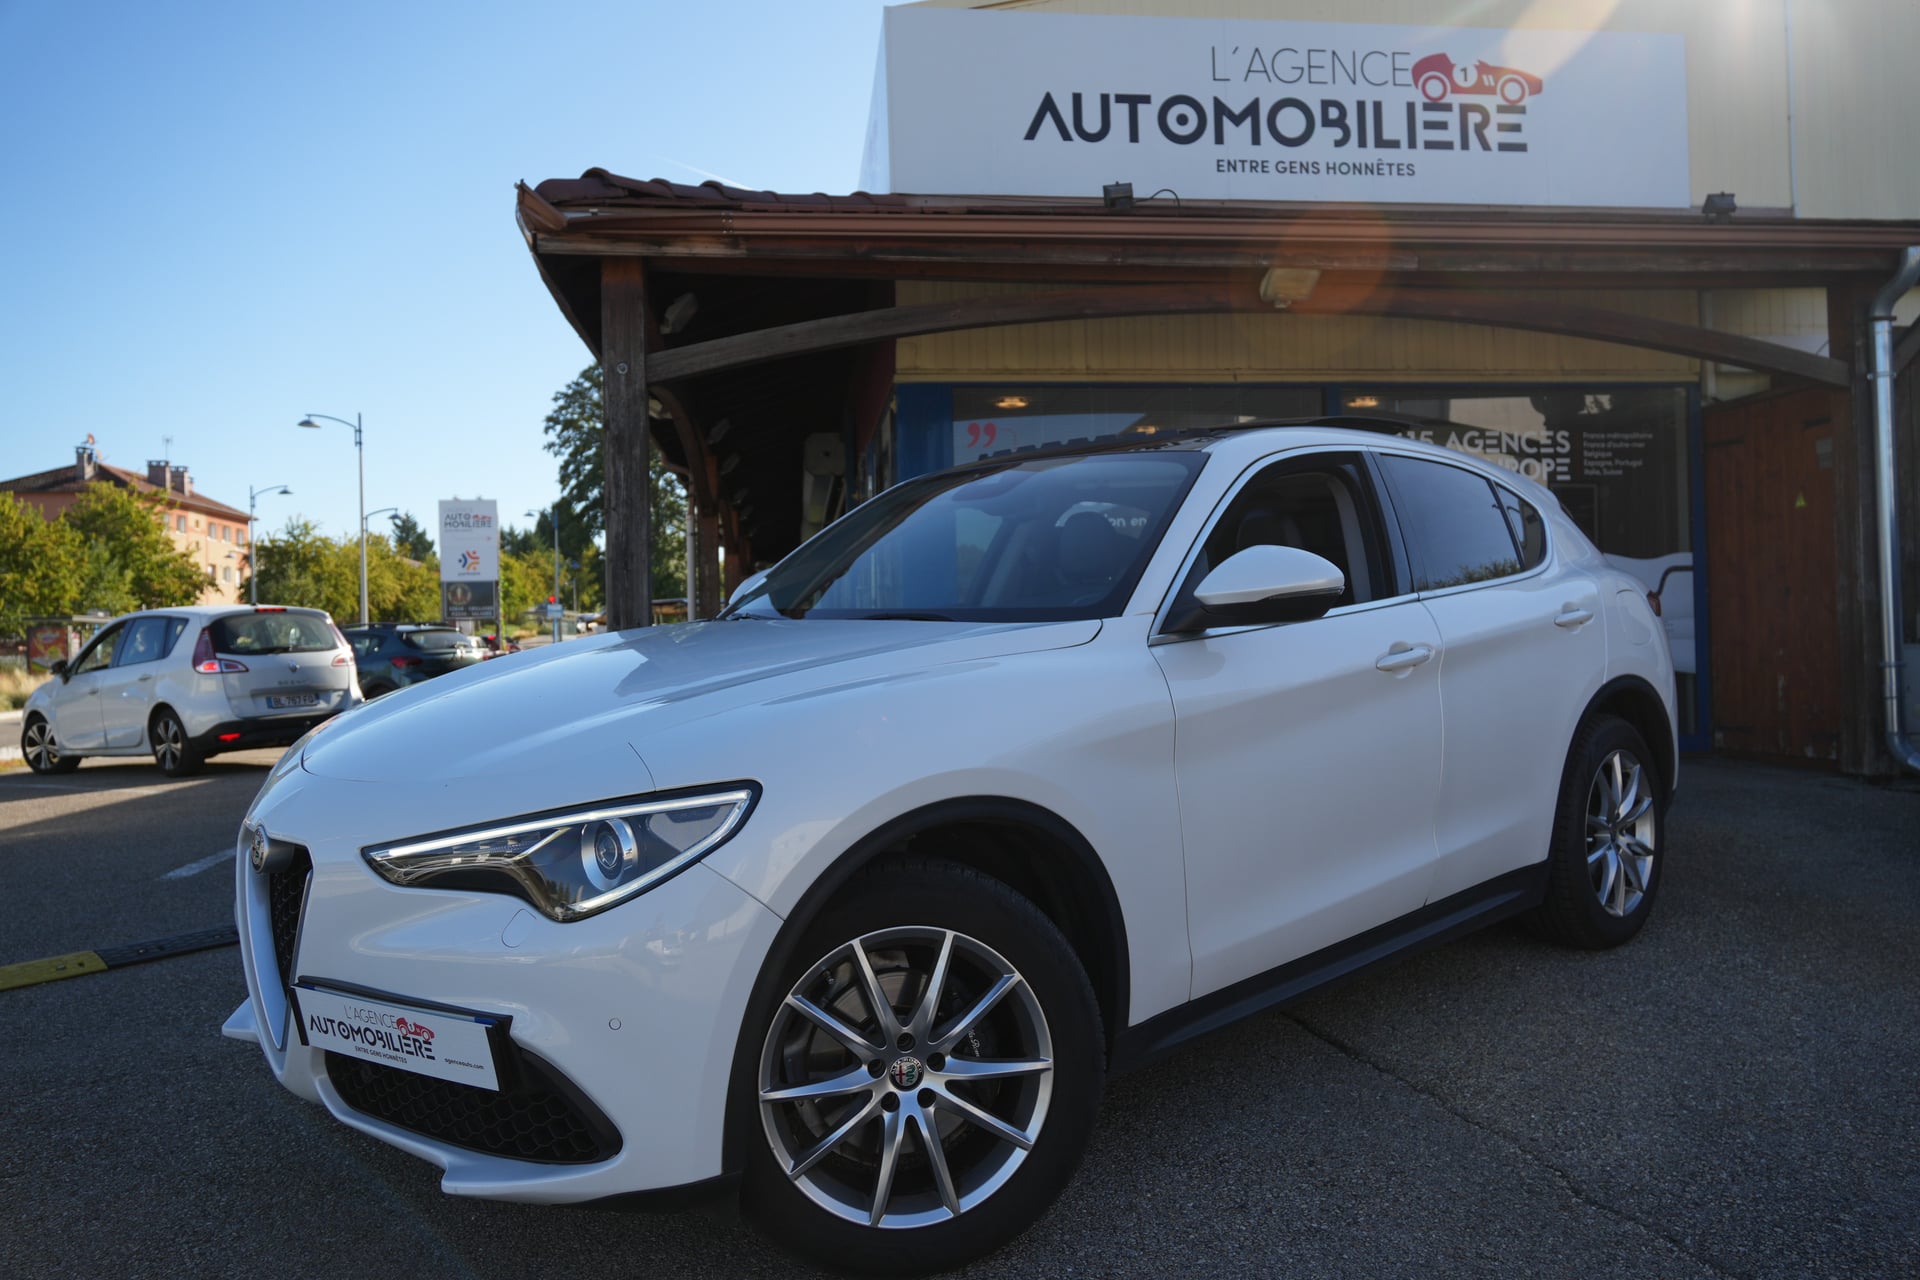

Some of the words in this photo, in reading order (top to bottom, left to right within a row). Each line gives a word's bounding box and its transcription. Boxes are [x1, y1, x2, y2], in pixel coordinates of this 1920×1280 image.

[1211, 46, 1412, 87] L'AGENCE
[1459, 67, 1468, 82] 1
[1216, 159, 1270, 173] ENTRE
[1275, 160, 1320, 175] GENS
[1326, 158, 1416, 176] HONNÊTES
[1446, 430, 1571, 454] AGENCES
[344, 1004, 398, 1030] L'AGENCE
